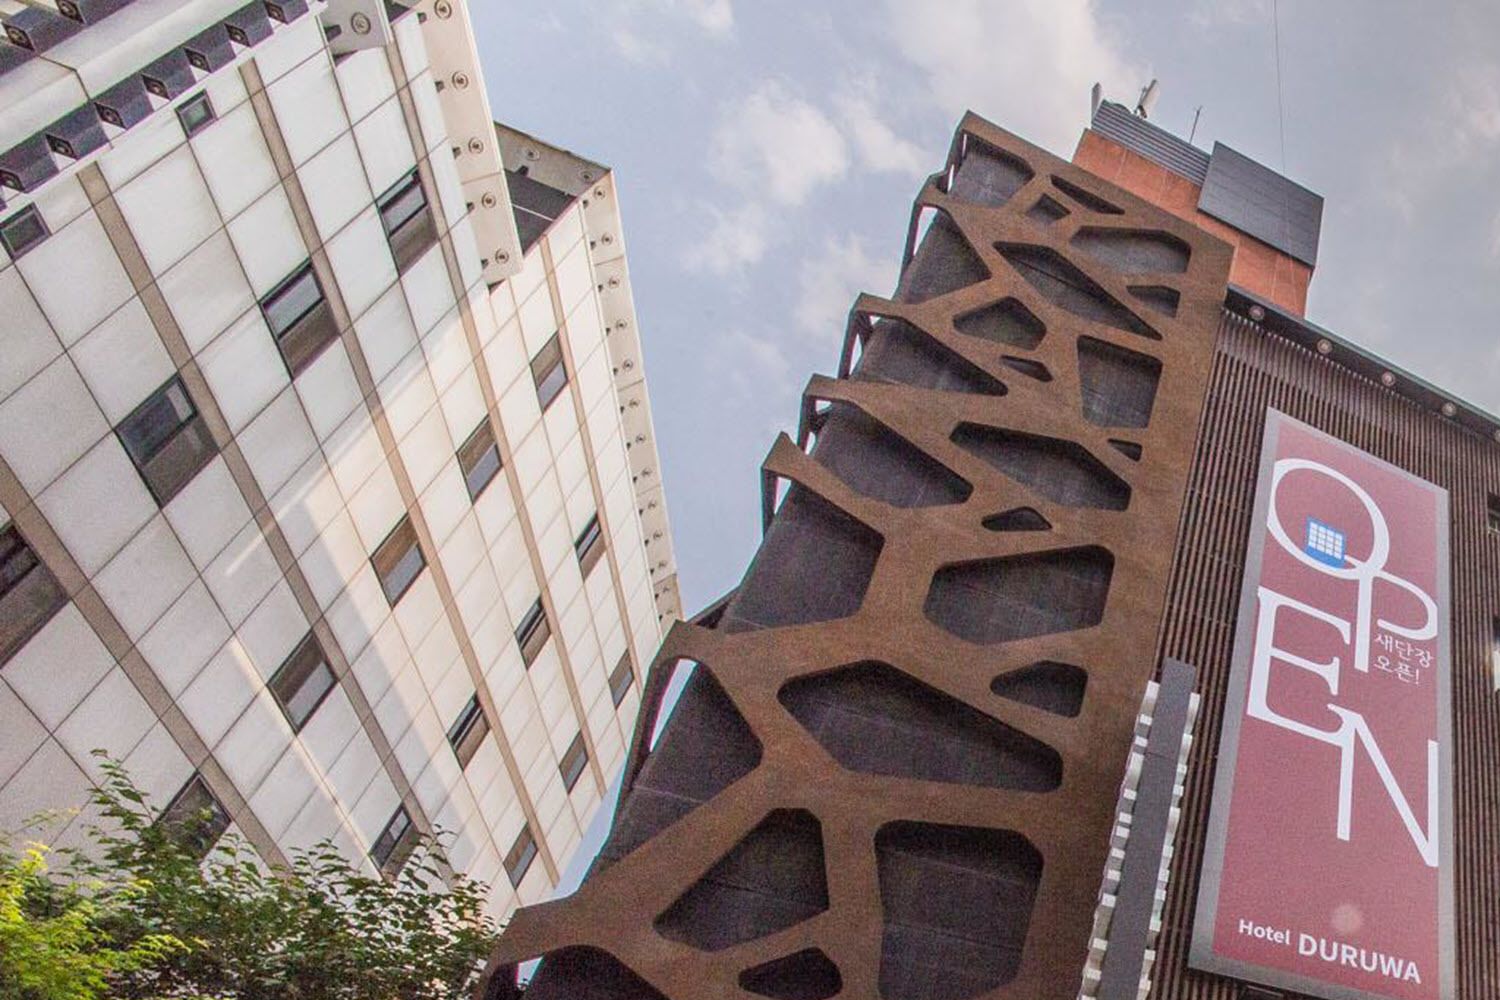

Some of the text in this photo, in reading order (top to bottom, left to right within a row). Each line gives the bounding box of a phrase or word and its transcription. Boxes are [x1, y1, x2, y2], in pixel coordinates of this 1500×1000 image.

[1247, 458, 1438, 867] OPEN
[1373, 655, 1420, 686] 오픈!
[1374, 633, 1434, 669] 새단장
[1238, 918, 1422, 985] Hotel DURUWA
